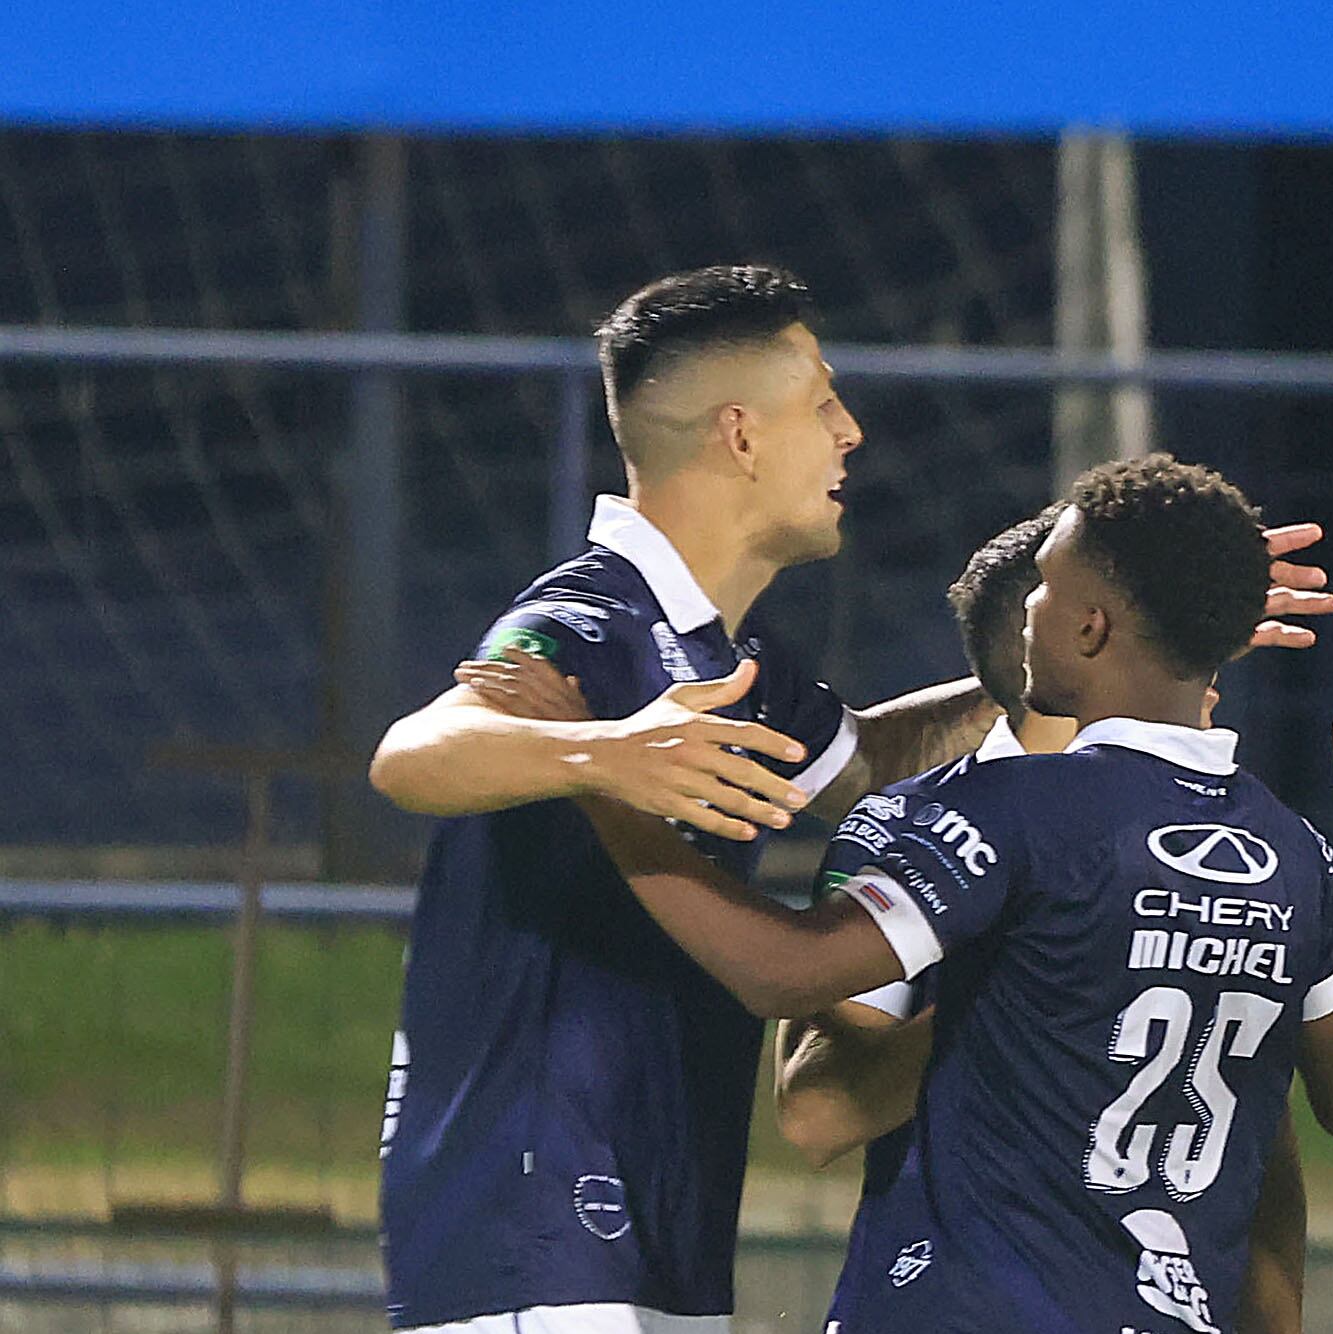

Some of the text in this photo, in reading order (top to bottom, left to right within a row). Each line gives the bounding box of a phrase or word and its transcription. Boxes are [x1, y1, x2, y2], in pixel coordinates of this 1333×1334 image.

[1133, 889, 1294, 931] CHERY
[1128, 930, 1293, 984] MICHEL
[1083, 986, 1285, 1203] 25
